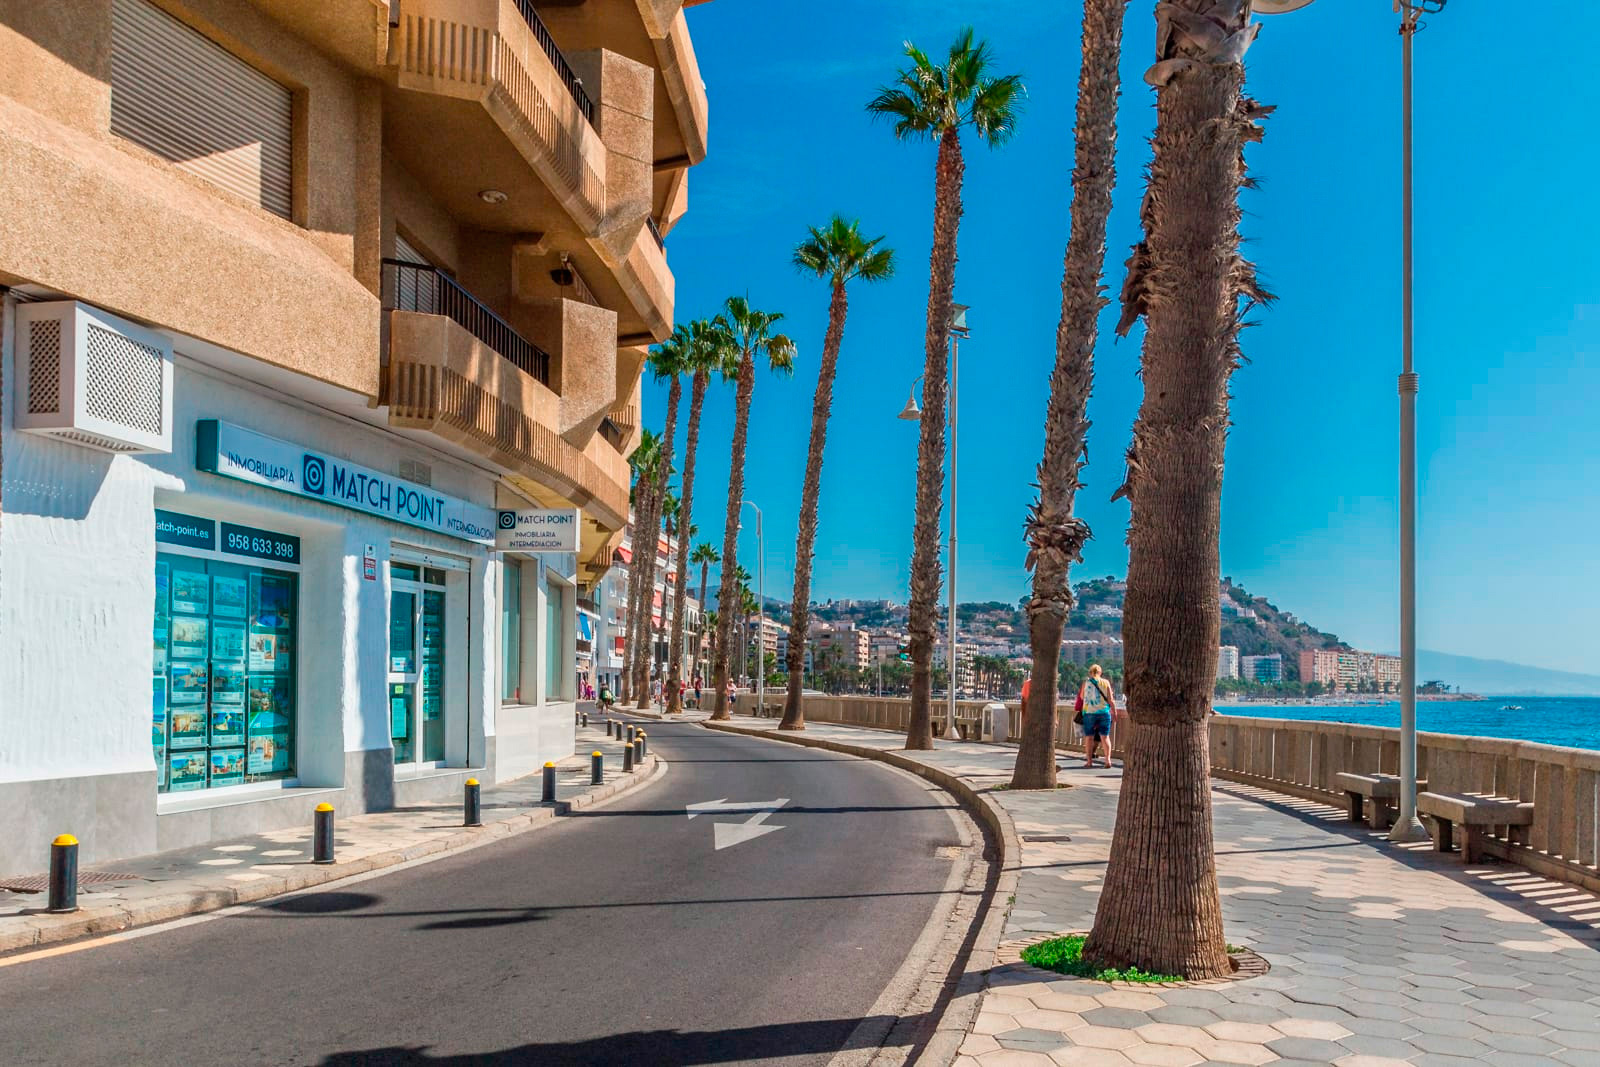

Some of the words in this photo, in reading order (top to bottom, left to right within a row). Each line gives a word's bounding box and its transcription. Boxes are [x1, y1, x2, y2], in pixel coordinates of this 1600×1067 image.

[228, 451, 295, 484] INMOBILIARIA
[333, 464, 391, 511] MATCH
[397, 486, 444, 526] POINT
[447, 517, 495, 539] INTERMEDIACION
[517, 515, 545, 524] MATCH
[547, 515, 574, 524] POINT
[228, 532, 250, 551] 958
[252, 537, 272, 555] 633
[274, 541, 294, 558] 398
